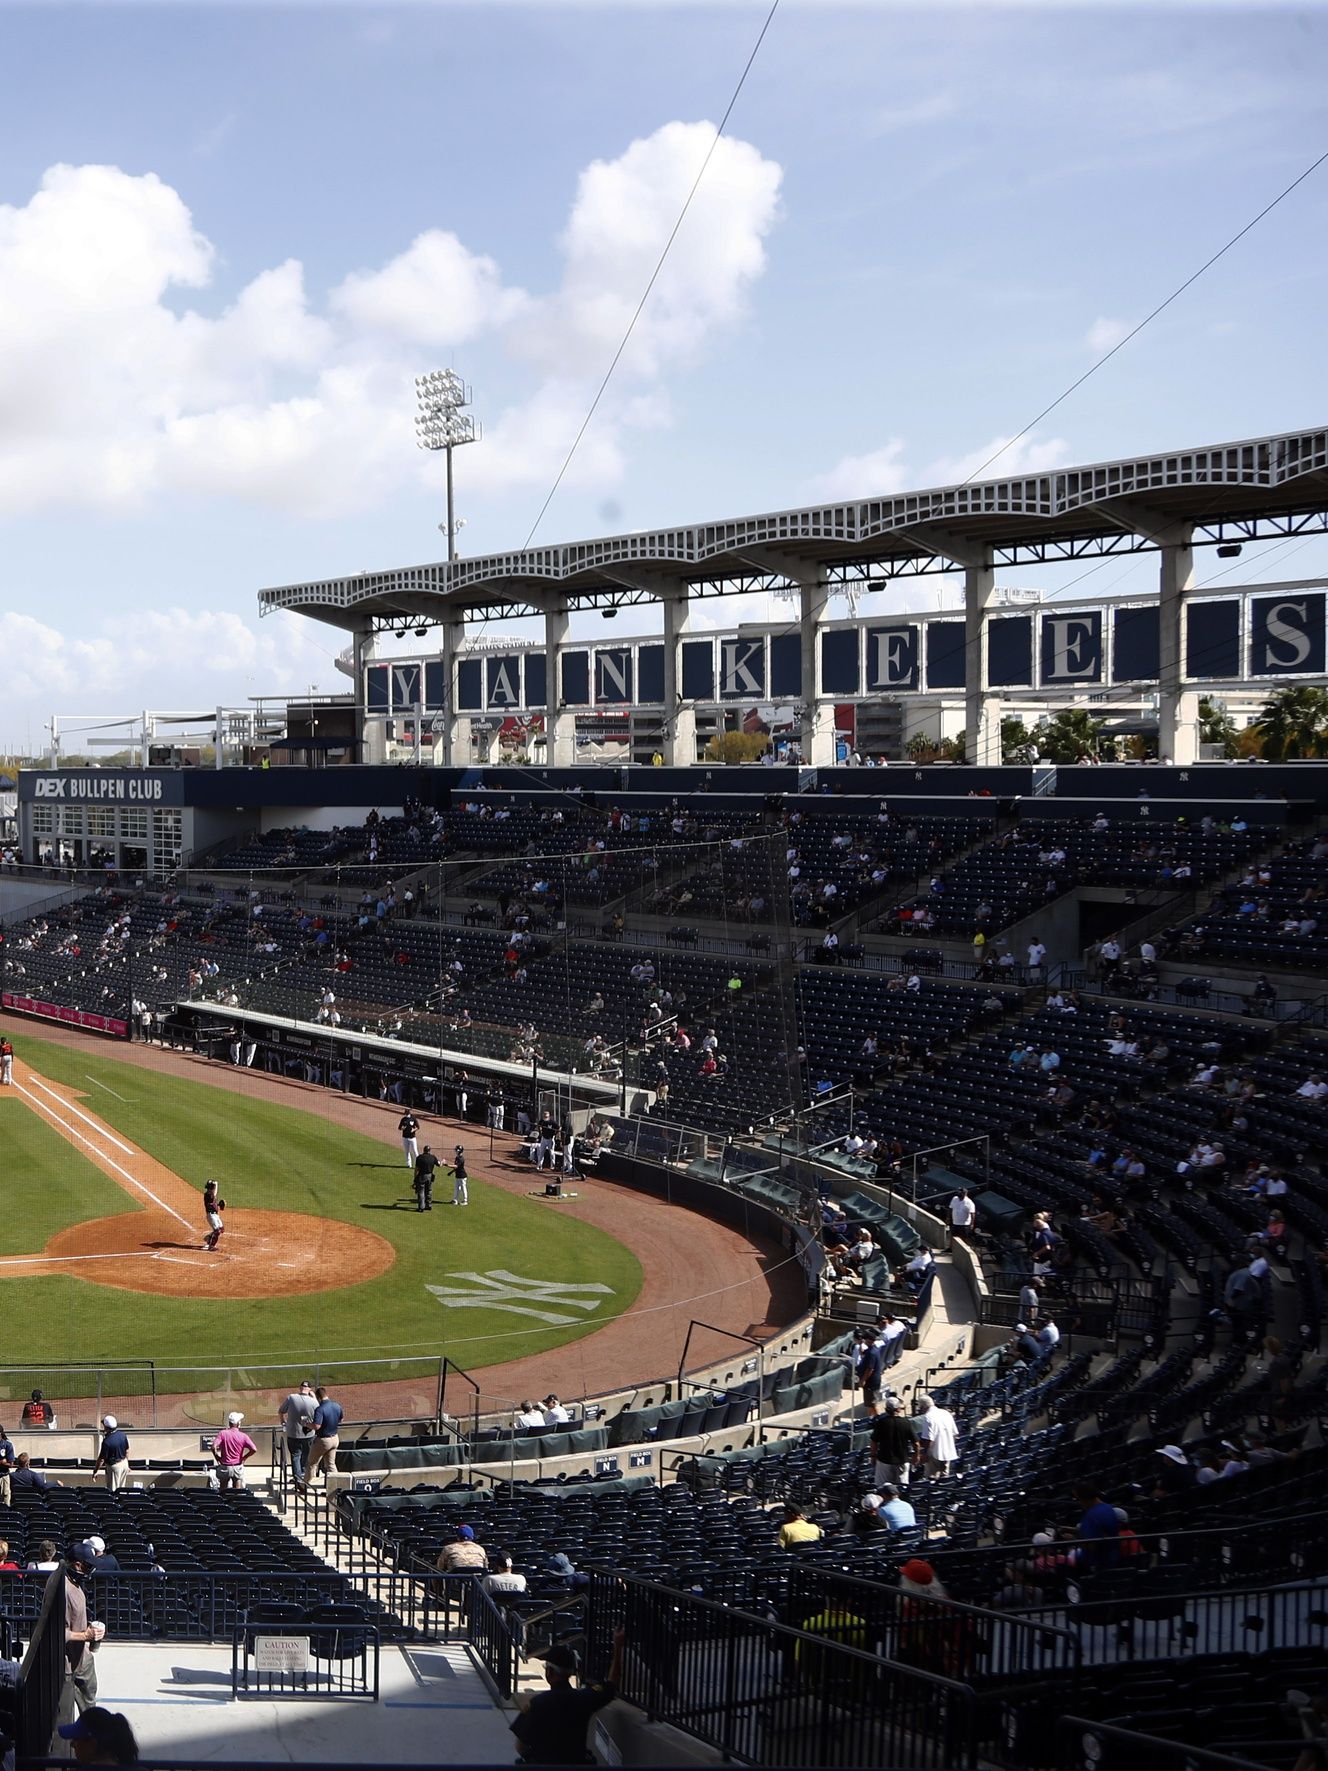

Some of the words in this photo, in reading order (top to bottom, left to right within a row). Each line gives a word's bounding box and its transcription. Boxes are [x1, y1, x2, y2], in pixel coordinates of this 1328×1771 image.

[393, 602, 1312, 705] YANKEES
[35, 778, 67, 797] DEX
[70, 779, 125, 798] BULLPEN
[129, 779, 162, 799] CLUB
[818, 1417, 823, 1425] L
[636, 1457, 645, 1466] M
[603, 1462, 611, 1471] N
[265, 1641, 300, 1649] CAUTION
